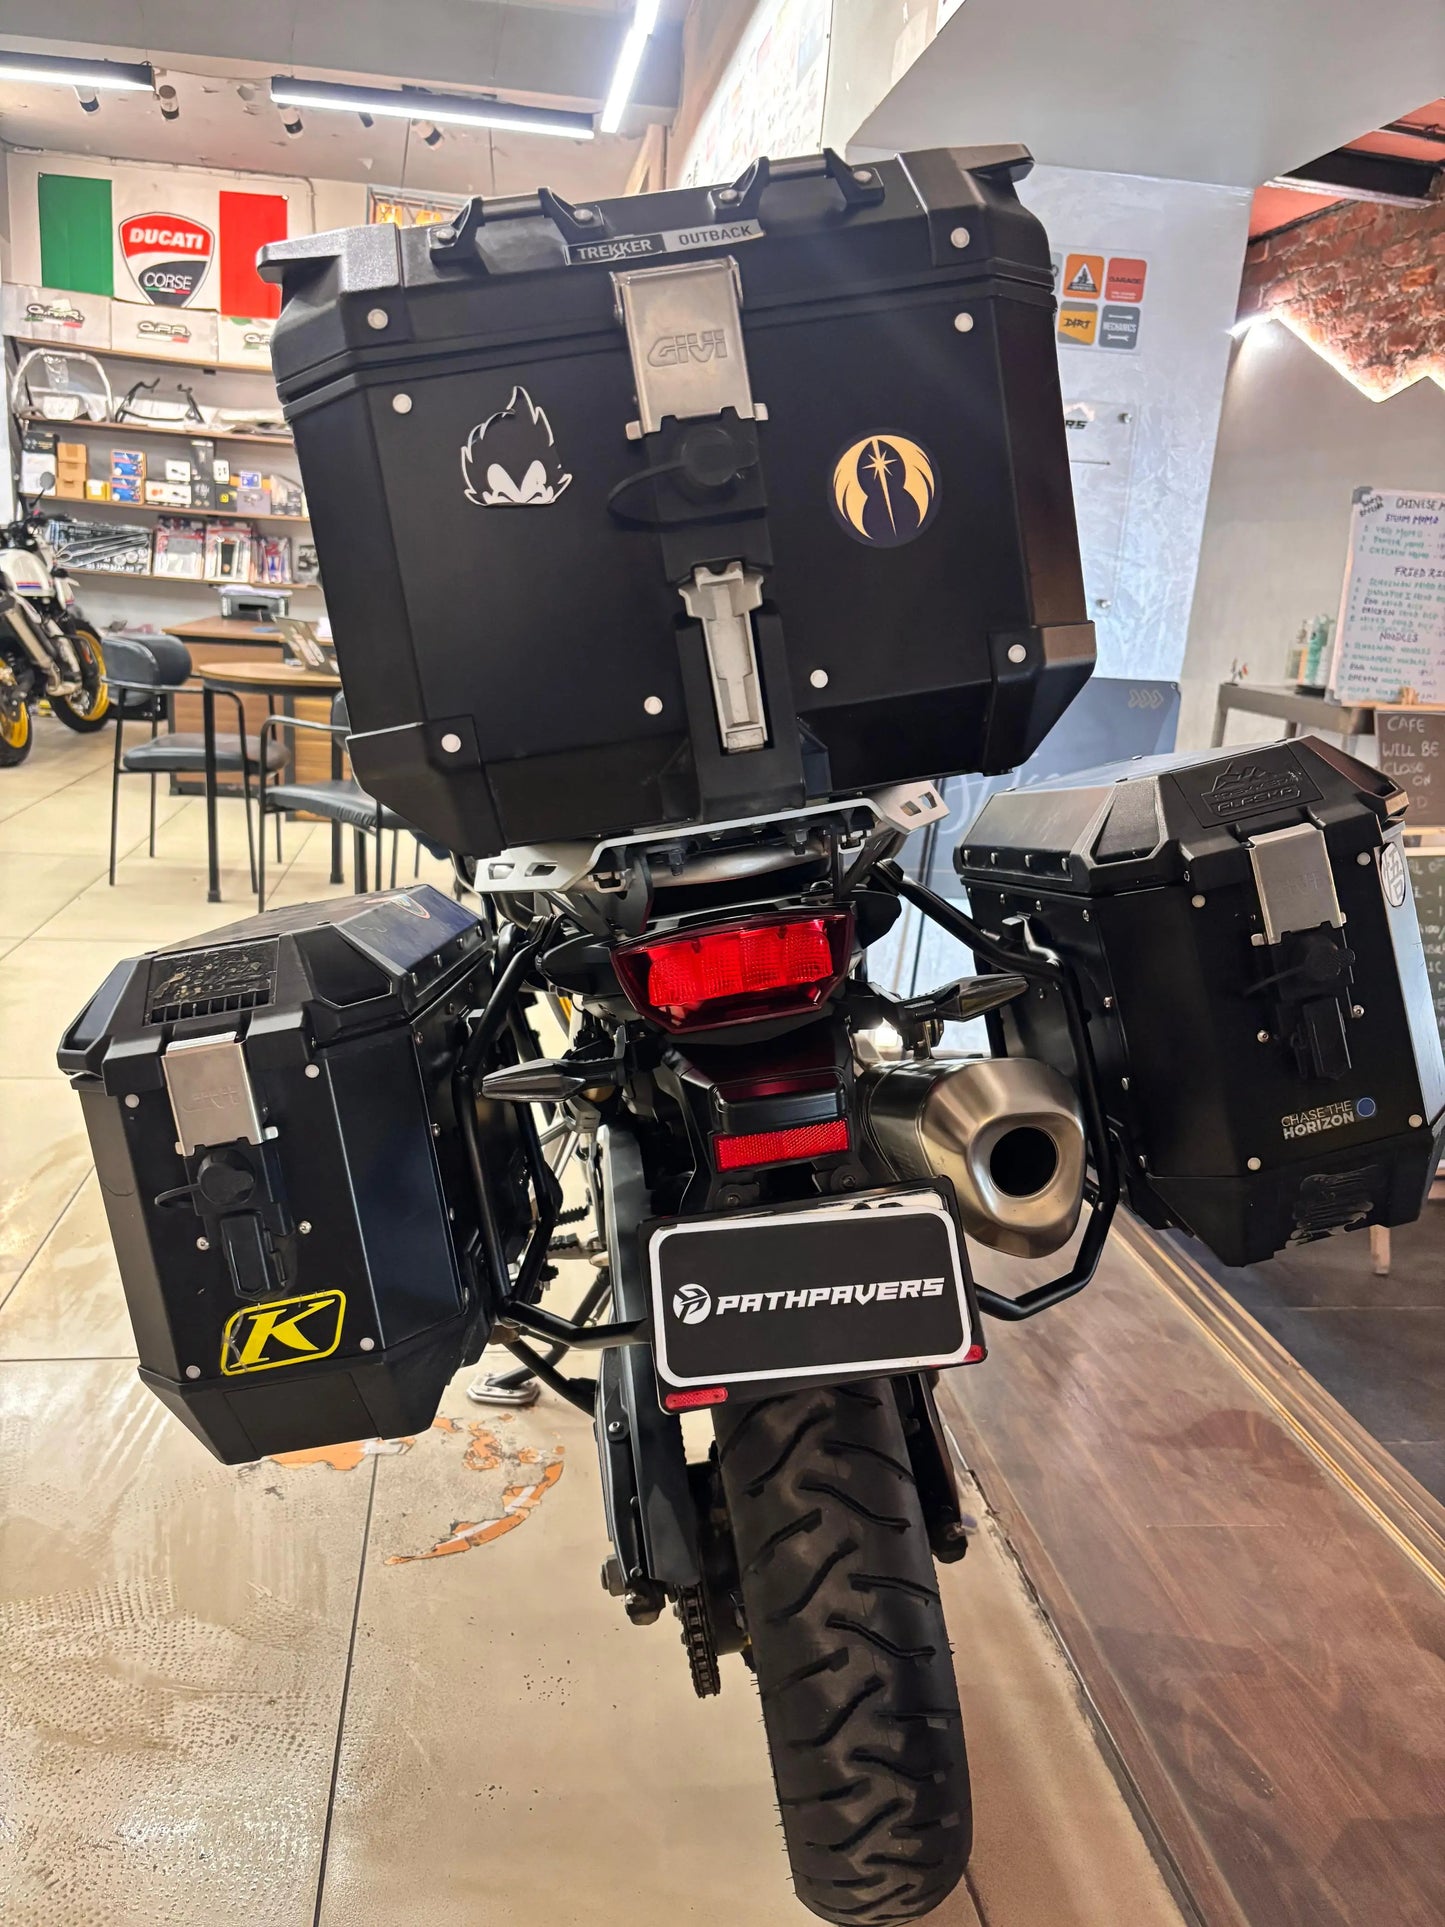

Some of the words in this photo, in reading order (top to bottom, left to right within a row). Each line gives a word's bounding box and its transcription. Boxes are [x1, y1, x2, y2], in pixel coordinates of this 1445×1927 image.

[129, 227, 204, 250] DUCATI
[577, 239, 652, 261] TREKKER
[679, 224, 753, 246] OUTBACK
[143, 271, 193, 290] CORSE
[1103, 321, 1137, 334] MECHANICS
[646, 329, 728, 368] GIVI
[1394, 567, 1426, 577] FRIED
[1387, 715, 1425, 733] CAFE
[1382, 742, 1416, 757] WILL
[1421, 740, 1439, 757] BE
[1412, 774, 1431, 786] ON
[1281, 1106, 1326, 1128] CHASE
[1327, 1100, 1353, 1115] THE
[1282, 1110, 1355, 1140] HORIZON
[716, 1277, 945, 1316] PATHPAVERS
